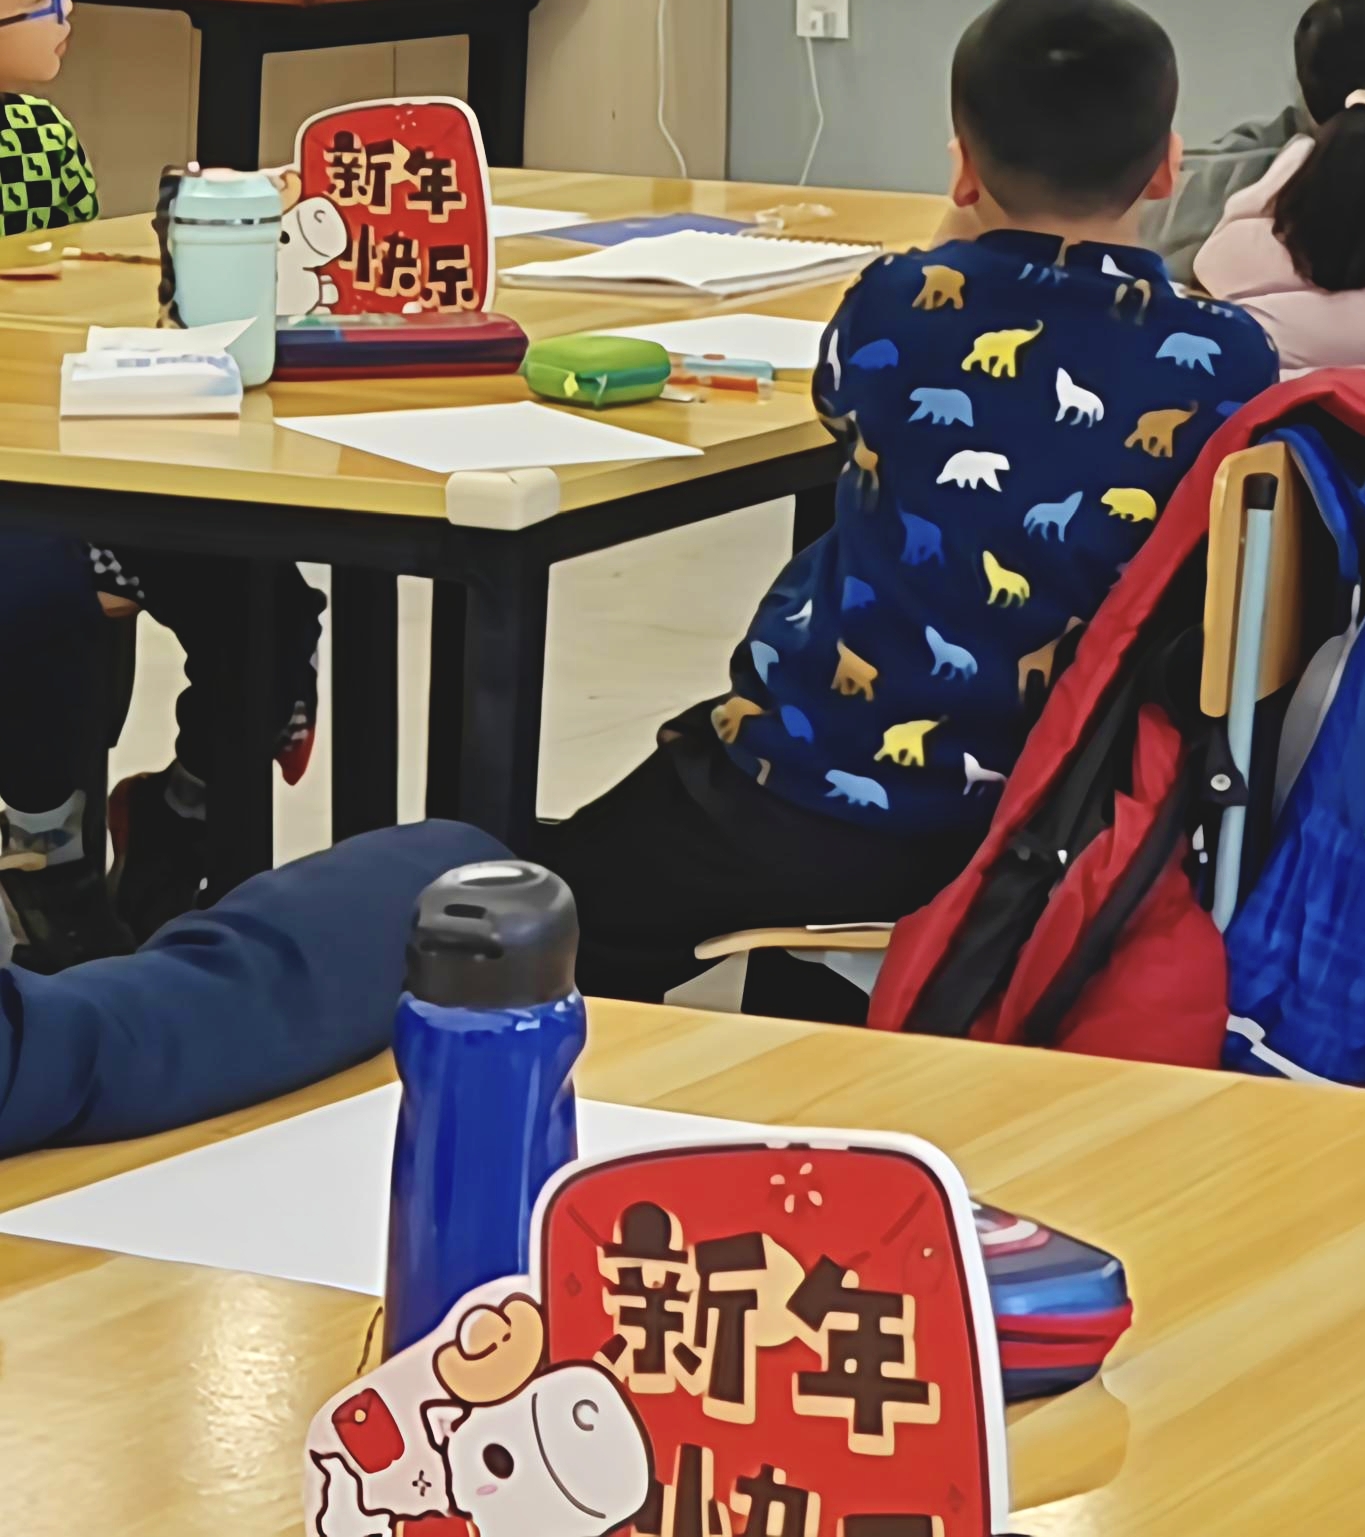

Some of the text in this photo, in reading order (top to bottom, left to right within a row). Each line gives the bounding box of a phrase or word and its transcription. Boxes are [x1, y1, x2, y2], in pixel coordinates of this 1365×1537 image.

[322, 130, 468, 224] 新年
[339, 223, 480, 313] 快乐
[593, 1200, 941, 1457] 新年
